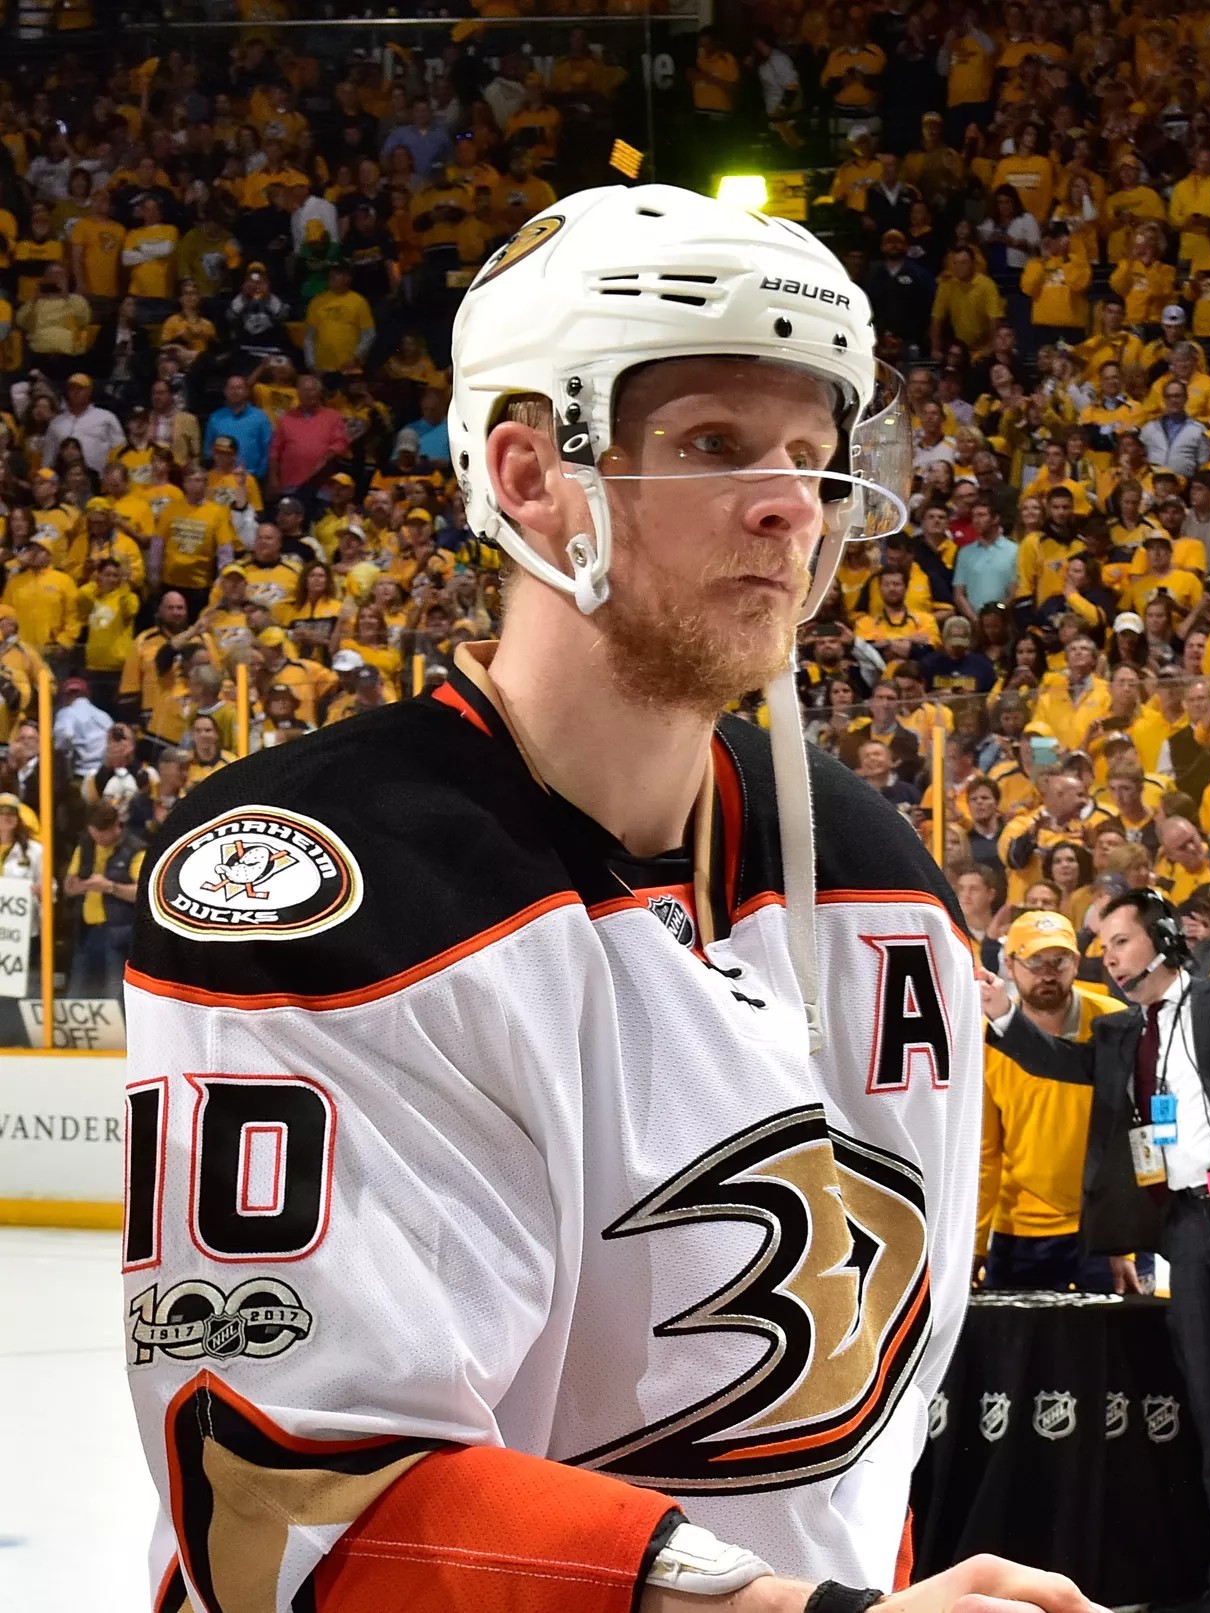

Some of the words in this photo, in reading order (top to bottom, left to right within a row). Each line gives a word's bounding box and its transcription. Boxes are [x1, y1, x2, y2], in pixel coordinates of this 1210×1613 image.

[760, 276, 850, 311] BAUER
[187, 820, 338, 879] ANAHEIM
[169, 893, 279, 925] DUCKS
[858, 934, 953, 1095] A
[122, 1073, 338, 1274] 10
[150, 1325, 196, 1340] 1917
[250, 1309, 300, 1323] 2017
[211, 1323, 239, 1350] NHL
